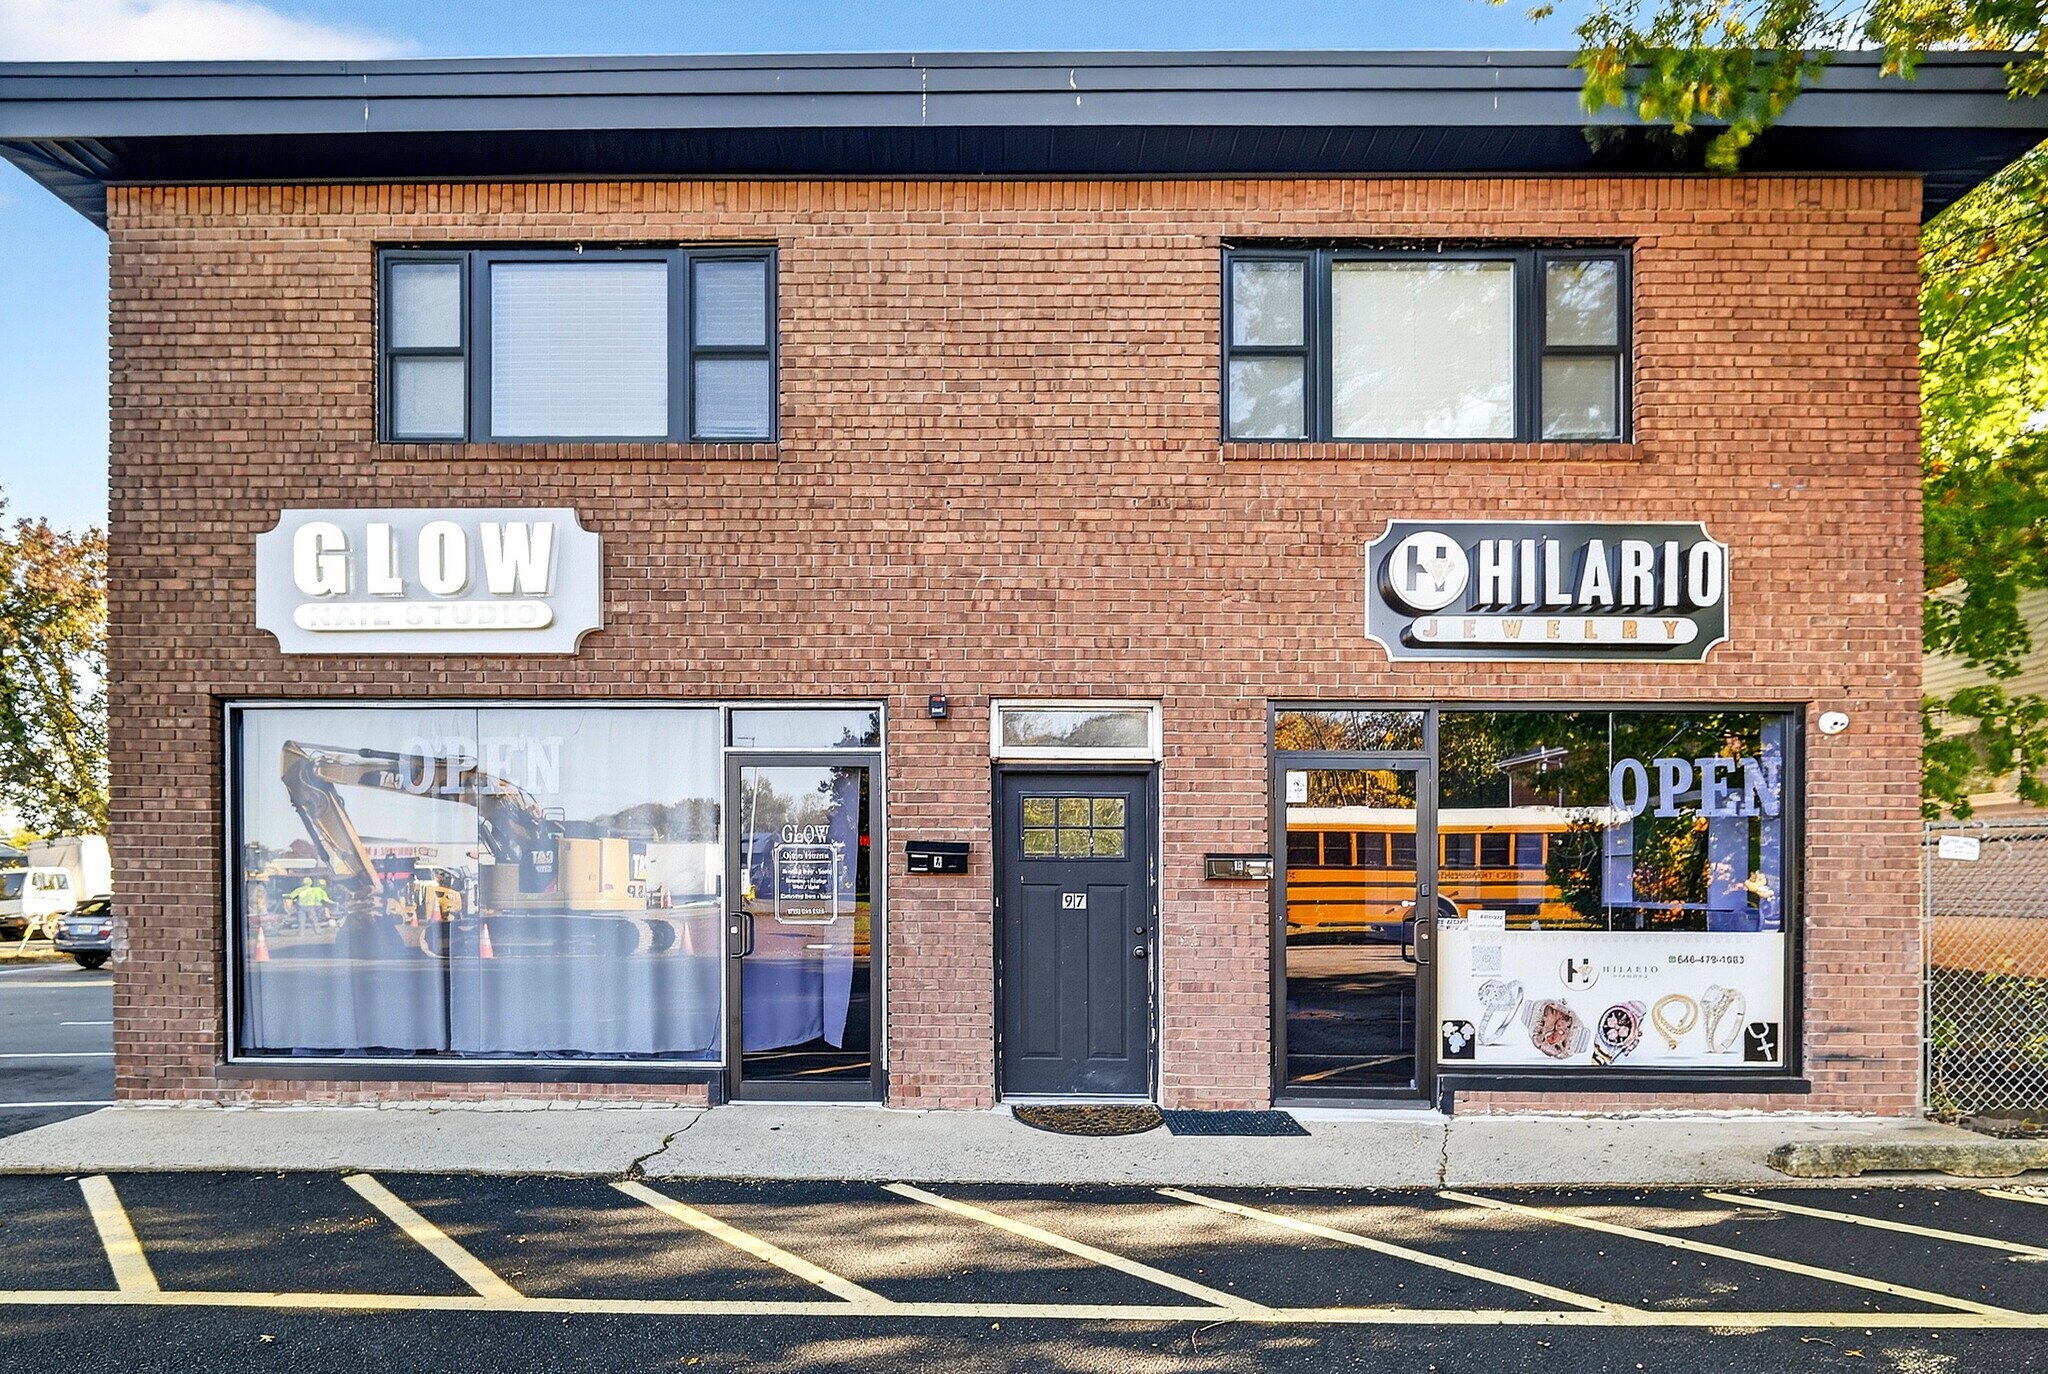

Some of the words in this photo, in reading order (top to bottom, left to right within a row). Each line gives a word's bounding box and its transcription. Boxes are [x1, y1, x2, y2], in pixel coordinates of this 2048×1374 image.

[293, 520, 556, 596] GLOW
[1478, 538, 1723, 608] HILARIO
[310, 605, 391, 627] NAIL
[405, 603, 538, 626] STUDIO
[1422, 618, 1680, 640] JEWELRY
[399, 735, 565, 795] OPEN
[1611, 756, 1782, 817] OPEN
[781, 823, 830, 844] GLOW
[1064, 894, 1085, 908] 97
[1602, 965, 1659, 974] HILARIO
